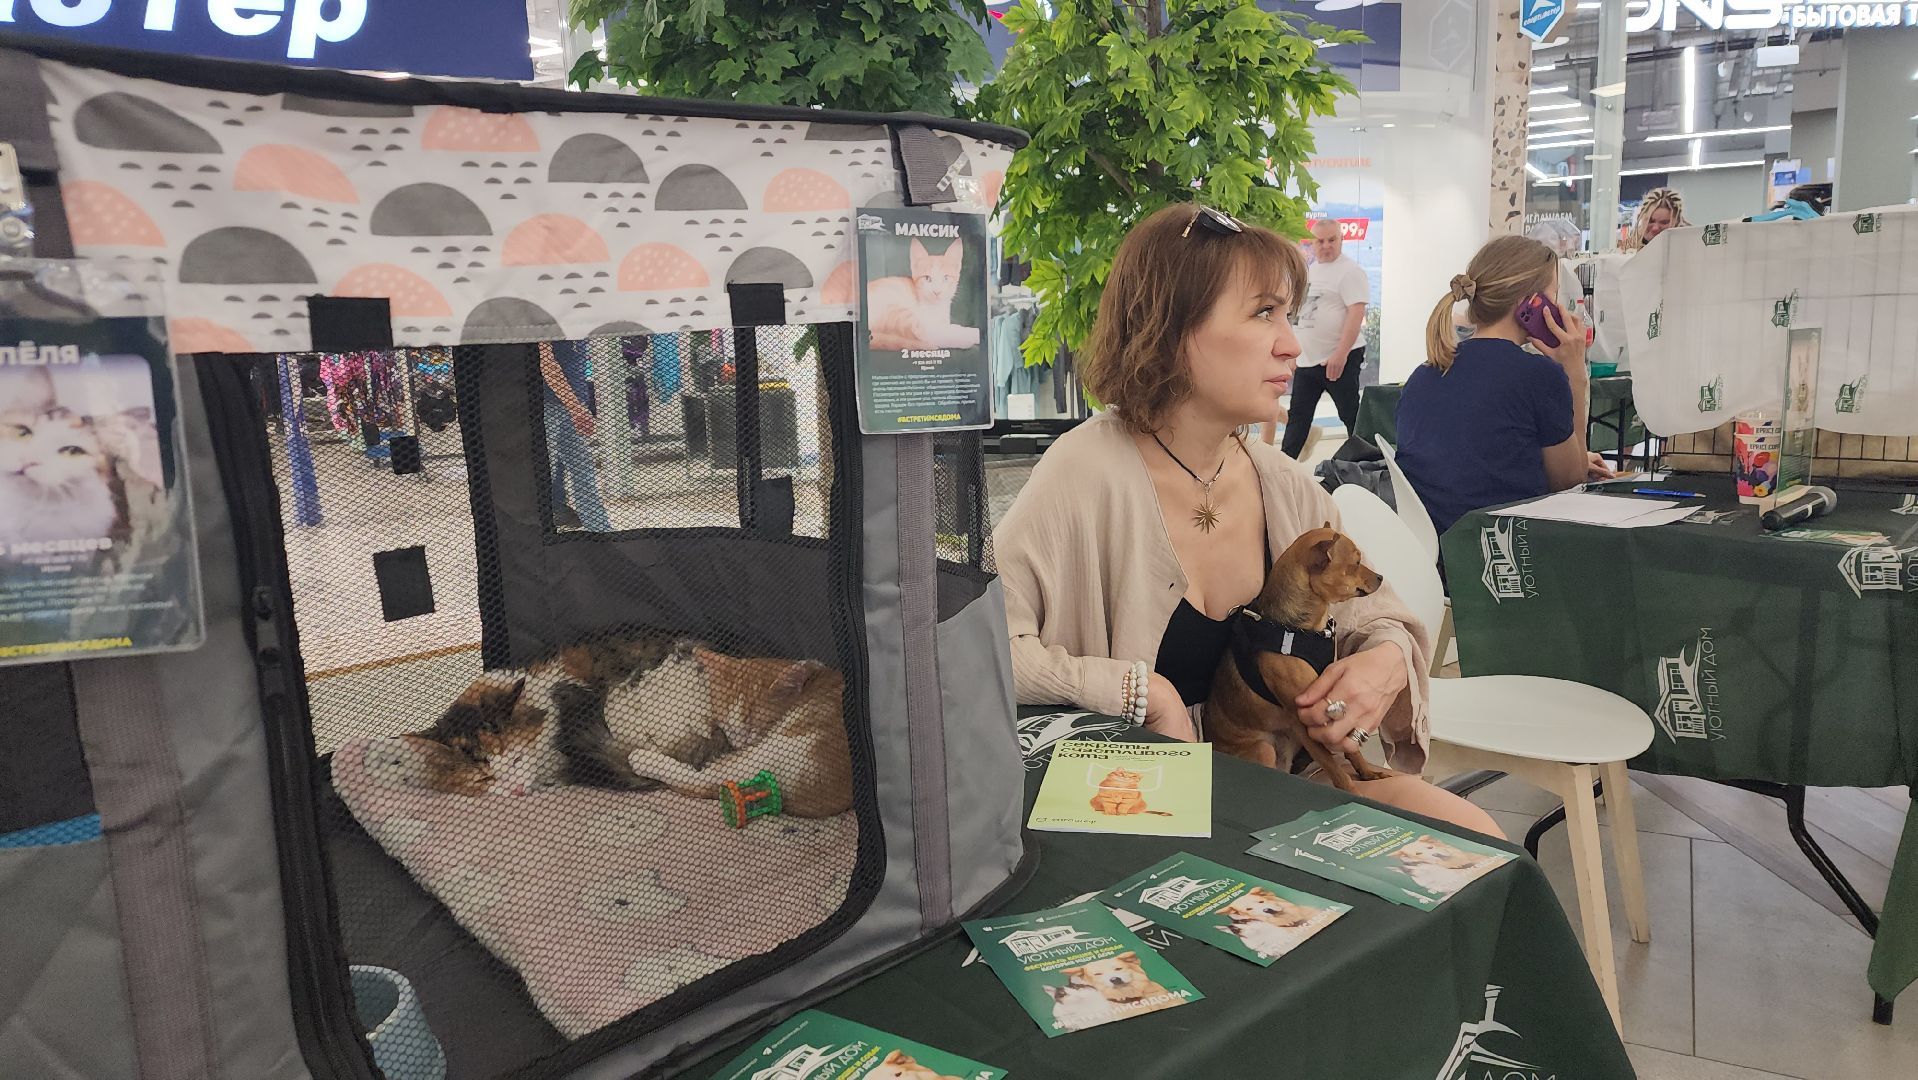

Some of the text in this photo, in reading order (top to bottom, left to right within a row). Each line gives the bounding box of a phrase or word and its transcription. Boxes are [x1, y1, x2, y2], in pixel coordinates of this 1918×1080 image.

[0, 0, 368, 59] стер
[1792, 3, 1901, 28] БЫТОВАЯ
[894, 222, 960, 238] МАКСИК
[901, 348, 951, 359] 2 месяца
[1514, 534, 1540, 599] УЮТНЫЙ
[1700, 627, 1727, 741] УЮТНЫЙ ДОМ
[1017, 936, 1118, 965] УЮТНЫЙ ДОМ
